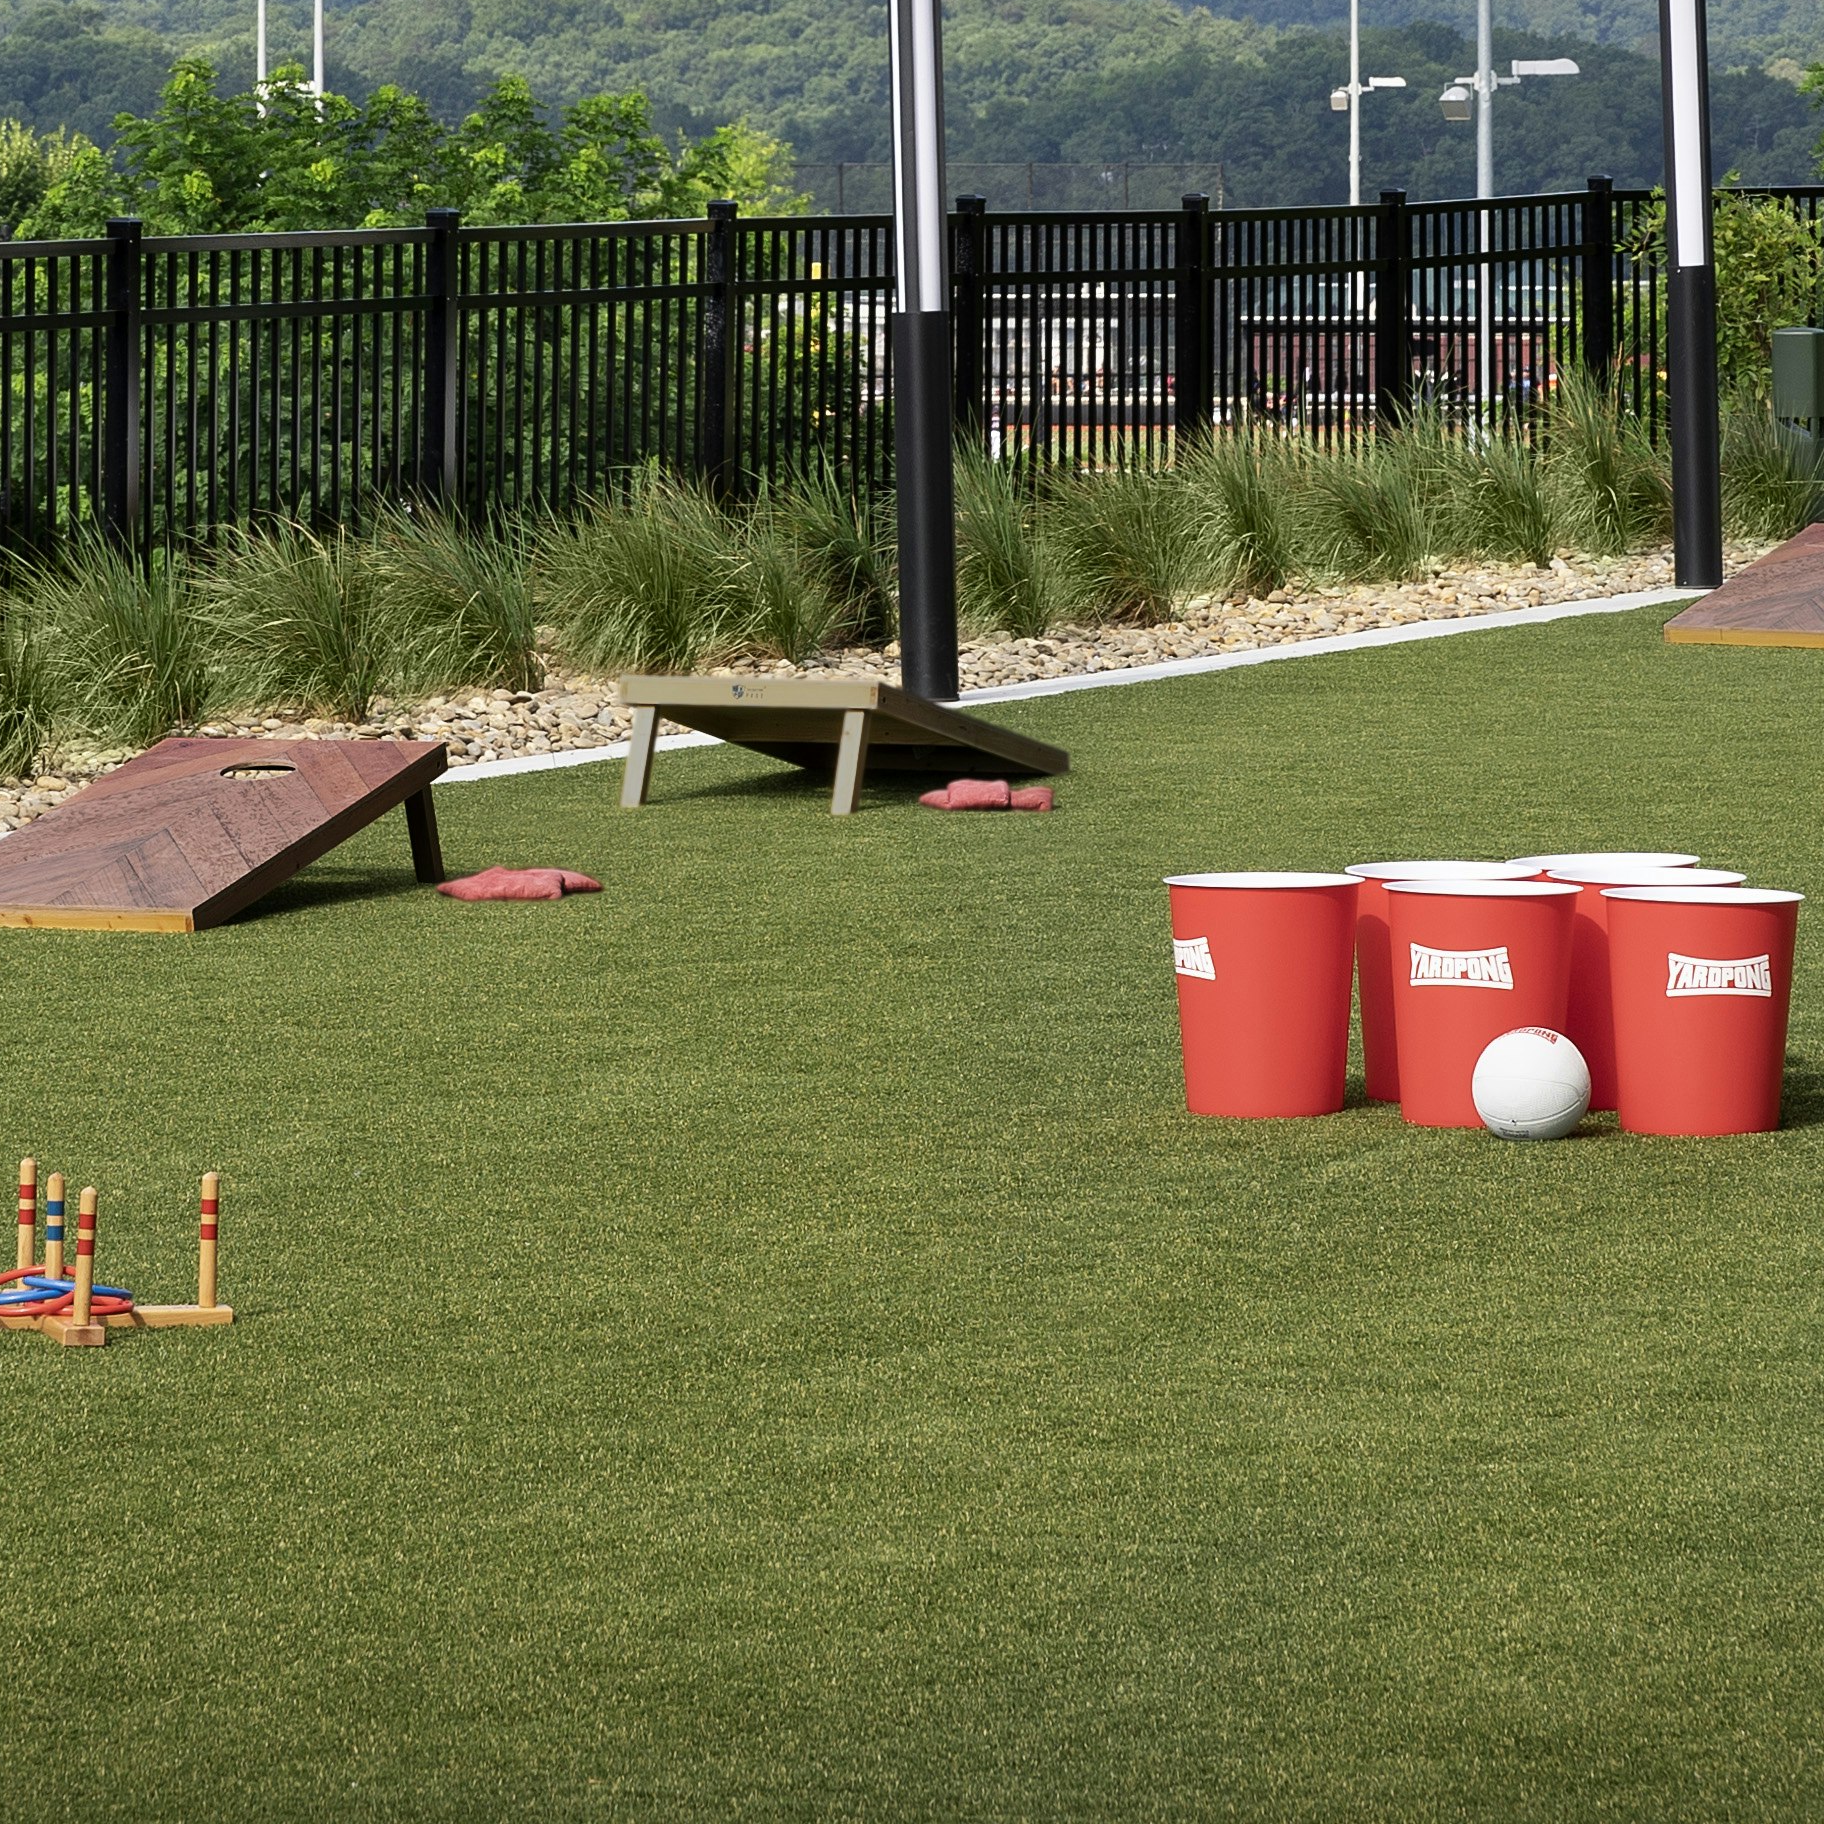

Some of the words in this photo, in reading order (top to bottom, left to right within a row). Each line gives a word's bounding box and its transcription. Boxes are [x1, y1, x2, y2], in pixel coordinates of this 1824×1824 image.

[1173, 943, 1215, 974] PONG
[1410, 948, 1513, 984] YARDPONG
[1667, 958, 1771, 991] YARDPONG
